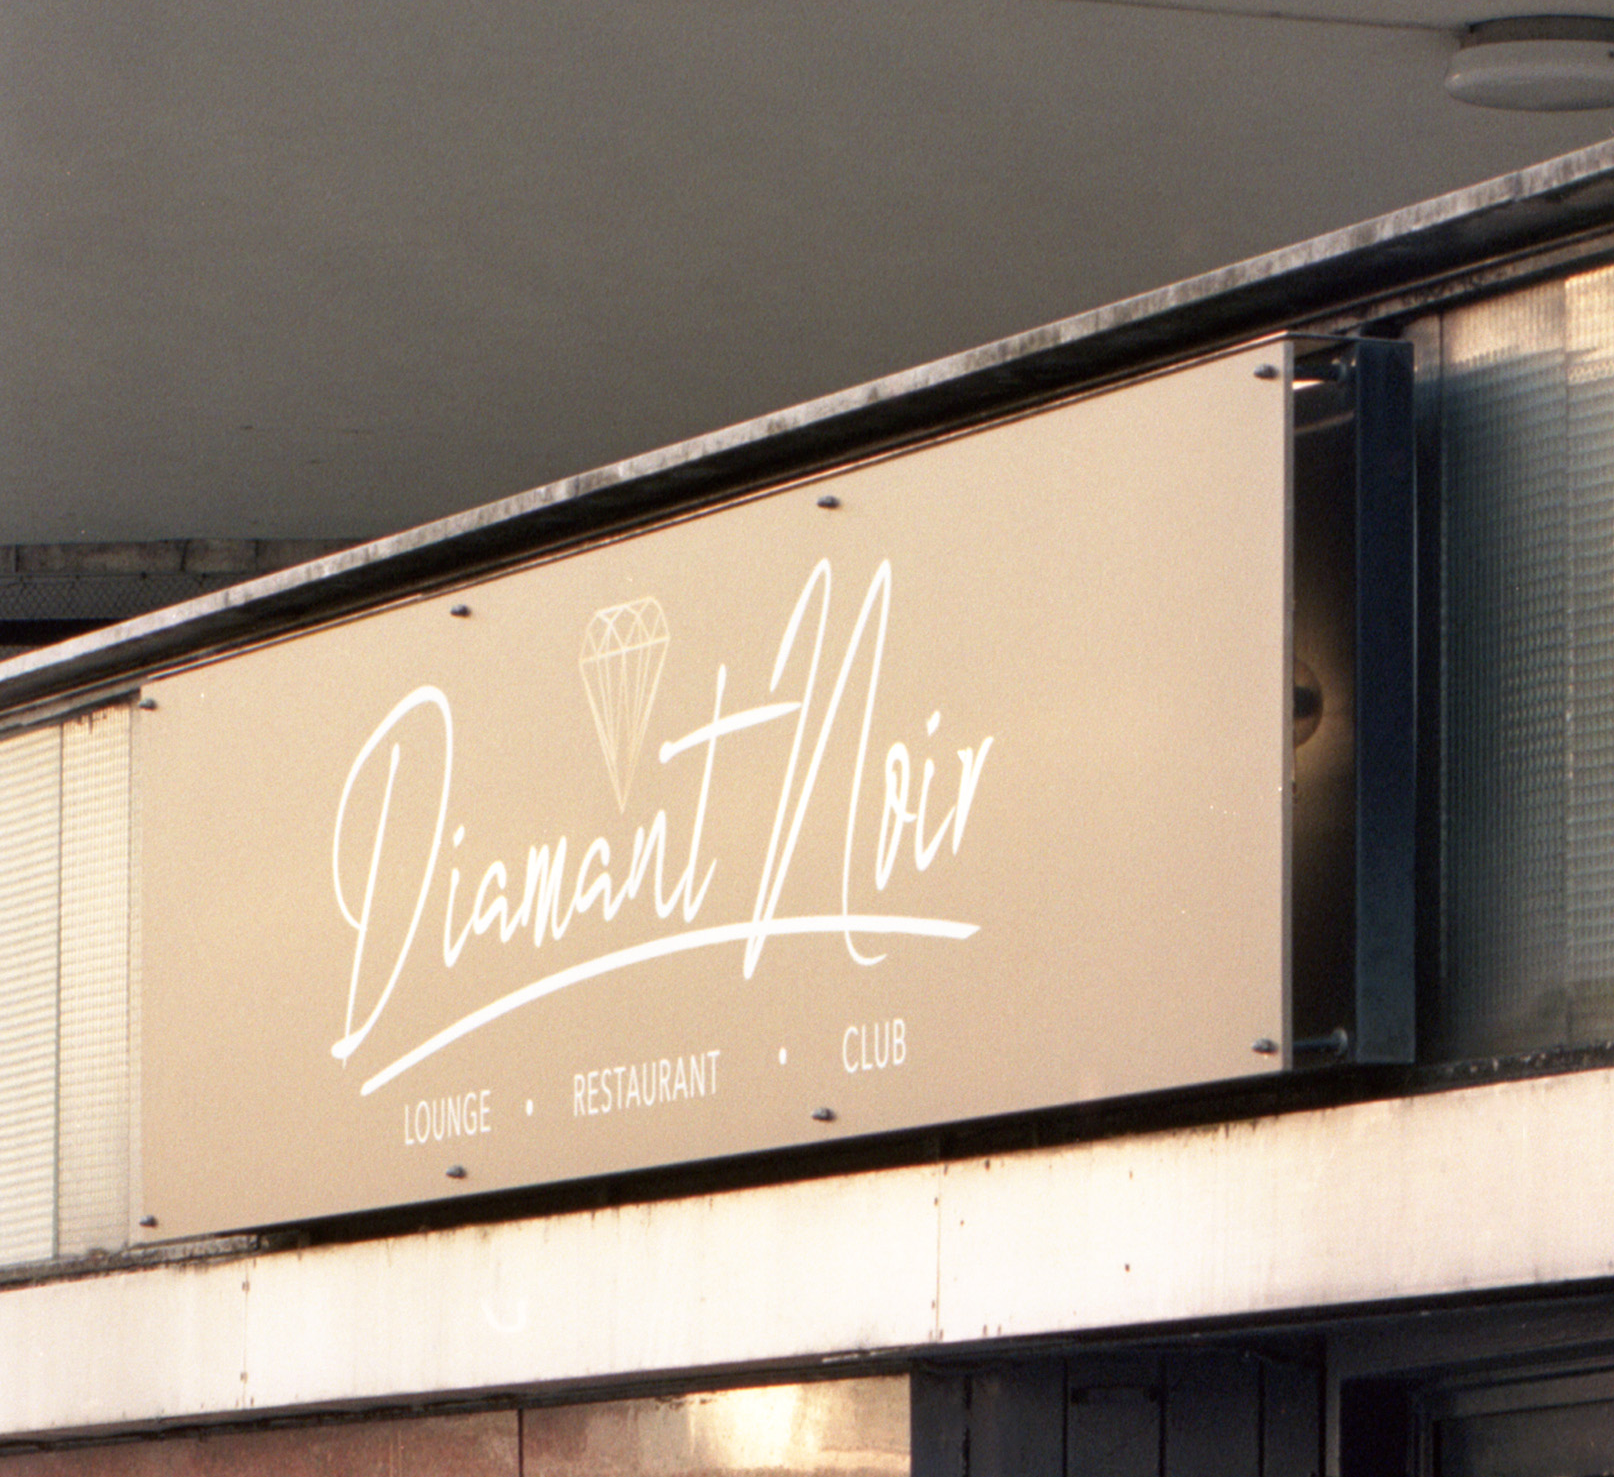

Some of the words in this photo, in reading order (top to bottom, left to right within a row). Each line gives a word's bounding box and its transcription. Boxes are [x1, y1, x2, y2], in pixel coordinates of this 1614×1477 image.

[331, 664, 802, 1068] Diamant
[743, 558, 994, 980] Noir
[404, 1089, 492, 1146] LOUNGE
[573, 1049, 721, 1117] RESTAURANT
[842, 1018, 907, 1074] CLUB
